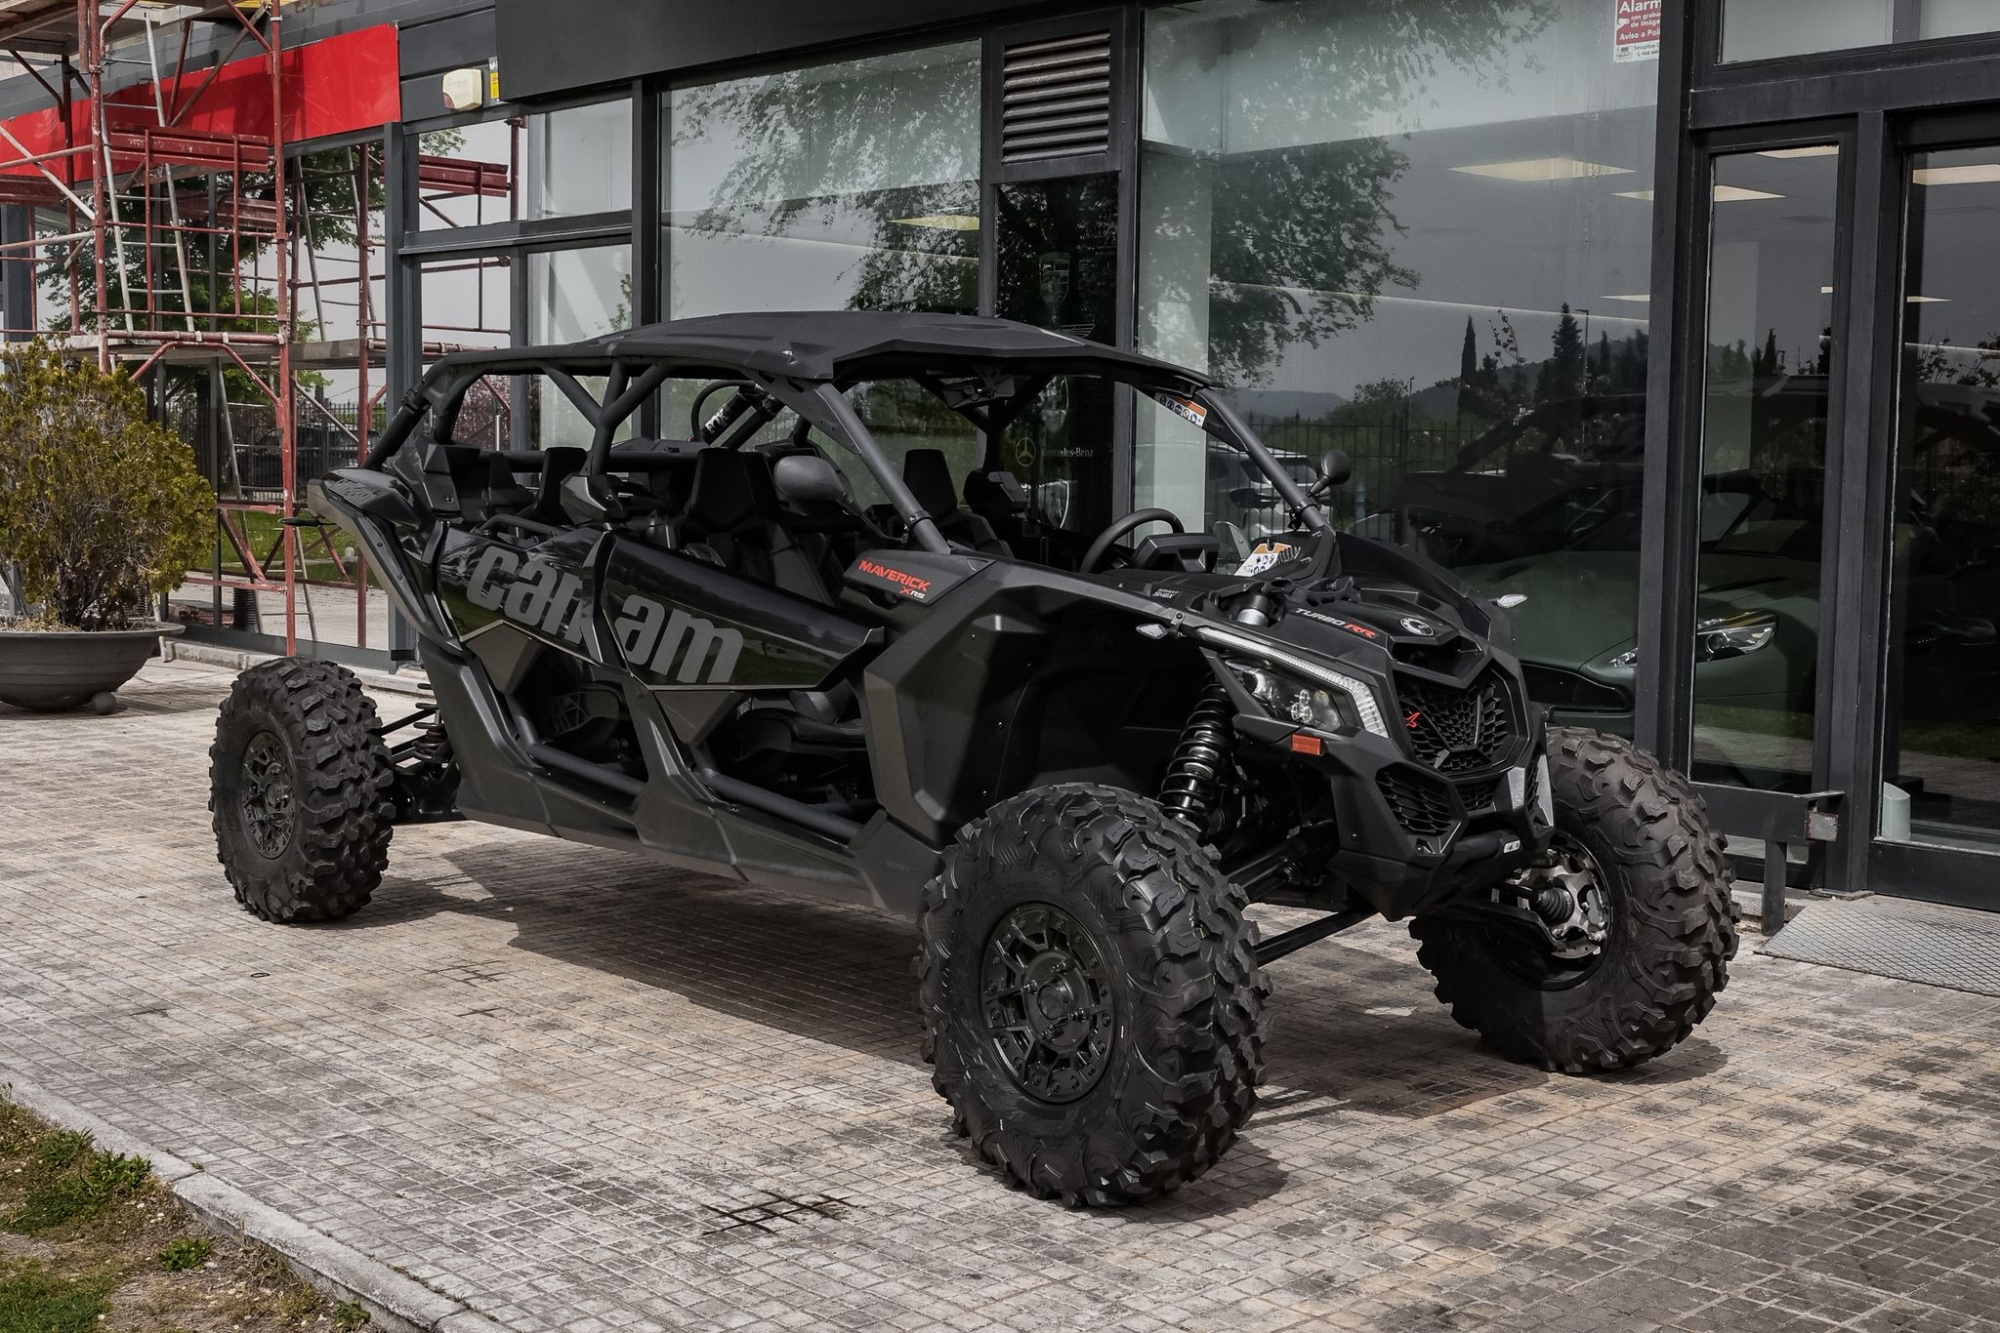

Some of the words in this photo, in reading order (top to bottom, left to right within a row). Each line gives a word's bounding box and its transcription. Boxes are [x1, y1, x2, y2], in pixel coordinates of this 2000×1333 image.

[1619, 32, 1640, 41] Aviso
[859, 559, 931, 592] MAVERICK
[1295, 607, 1346, 626] TURBO
